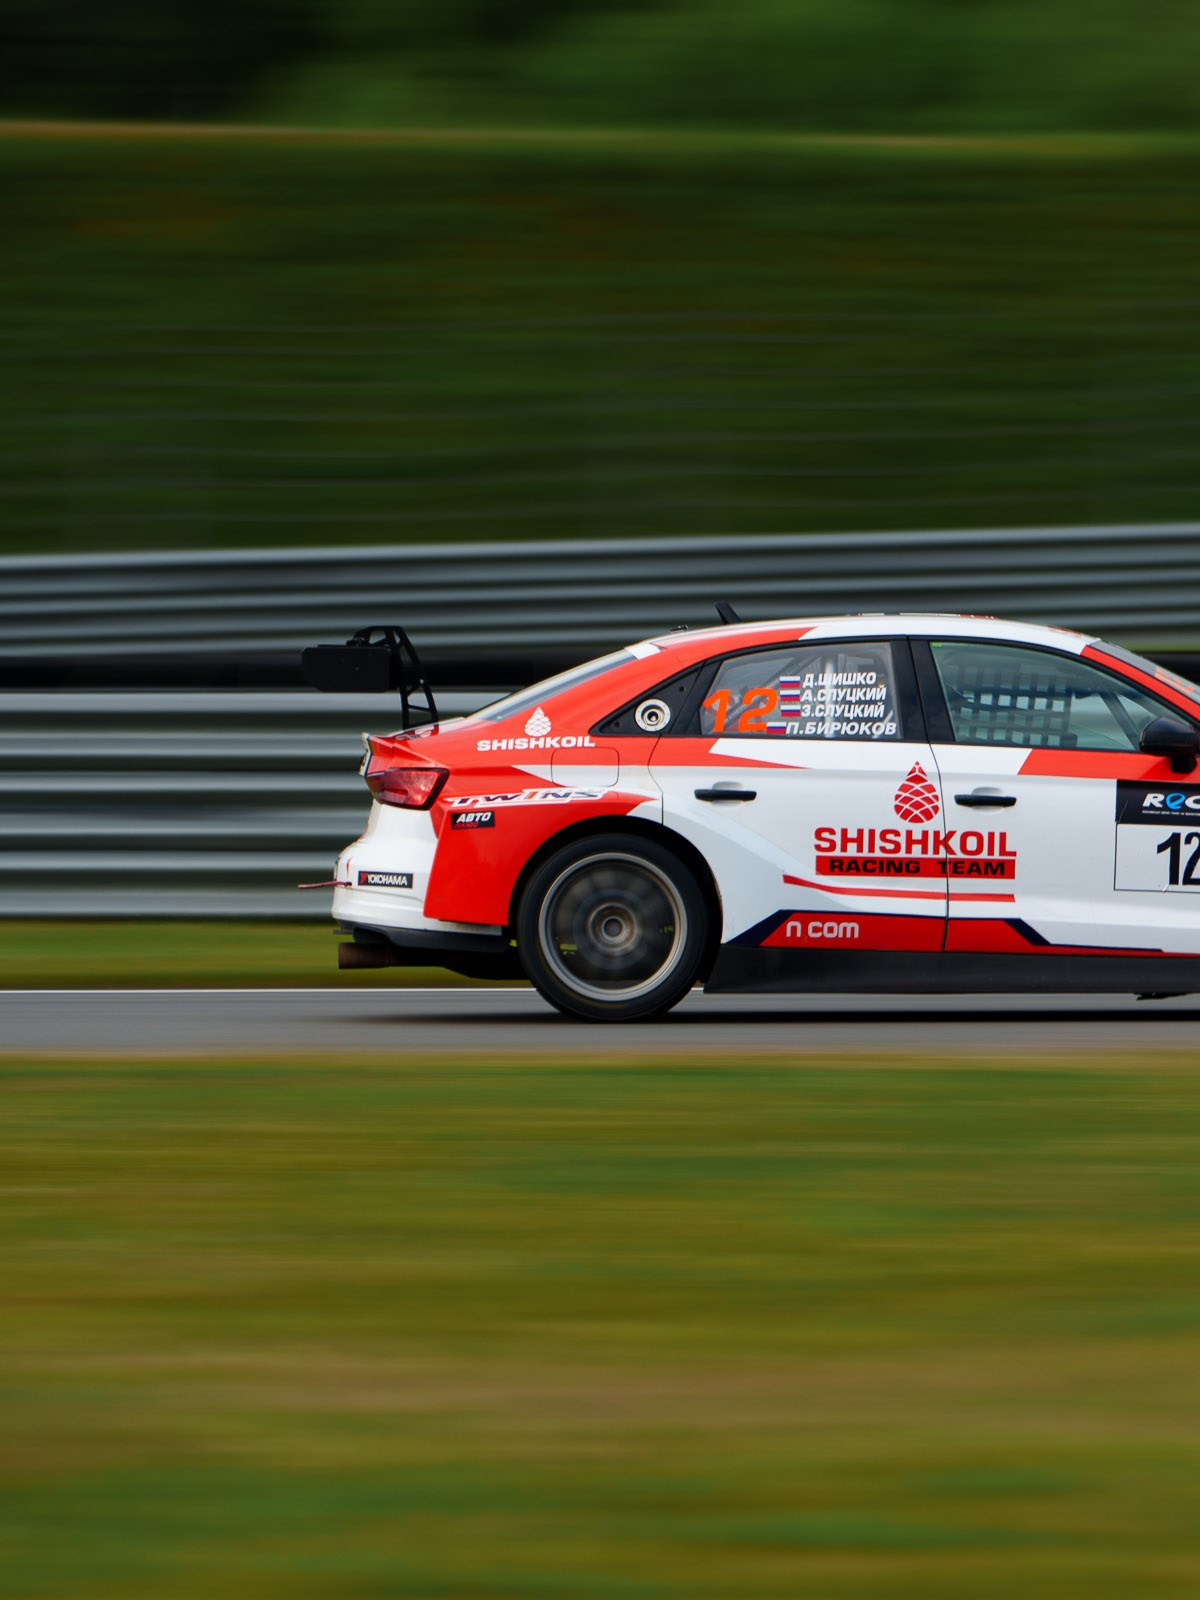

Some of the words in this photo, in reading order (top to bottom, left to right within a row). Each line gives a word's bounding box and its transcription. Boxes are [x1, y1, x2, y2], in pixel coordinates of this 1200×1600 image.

[800, 685, 887, 703] А.СЛУЦКИЙ
[702, 687, 778, 733] 12
[785, 721, 897, 736] П.БИРЮКОВ
[476, 736, 596, 752] SHISHKOIL
[814, 827, 1017, 857] SHISHKOIL
[829, 859, 921, 874] RACING
[937, 860, 1005, 876] TEAM
[367, 873, 409, 886] YOKOHAMA
